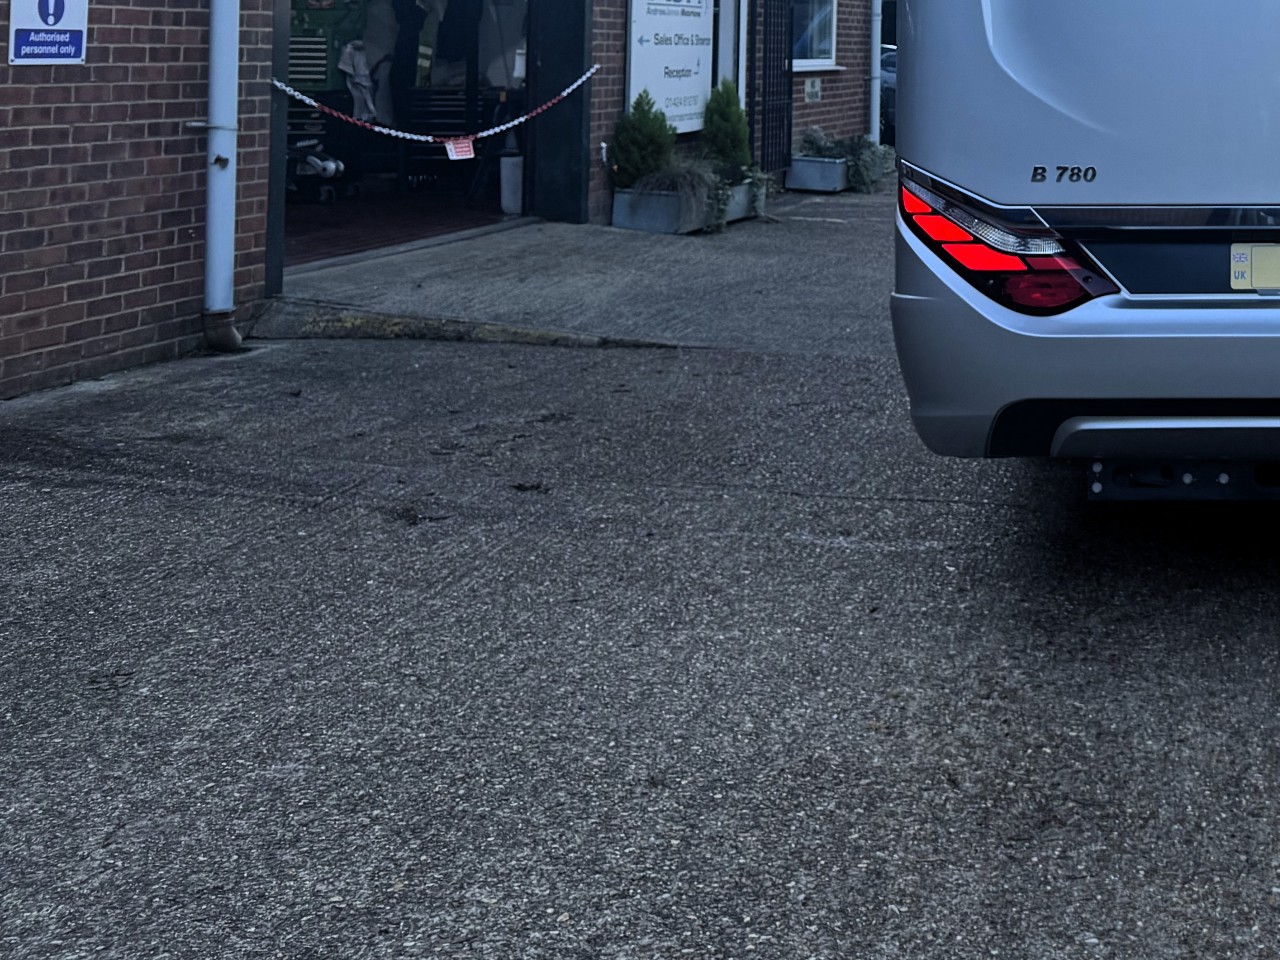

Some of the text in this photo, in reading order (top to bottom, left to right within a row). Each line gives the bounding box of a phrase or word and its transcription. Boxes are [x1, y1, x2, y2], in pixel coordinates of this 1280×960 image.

[29, 31, 70, 42] Authorised
[654, 32, 672, 46] Sales
[674, 33, 690, 46] Office
[21, 43, 75, 56] personnel only
[664, 65, 692, 81] Reception
[1031, 166, 1097, 183] B 780
[1234, 270, 1247, 281] UK
